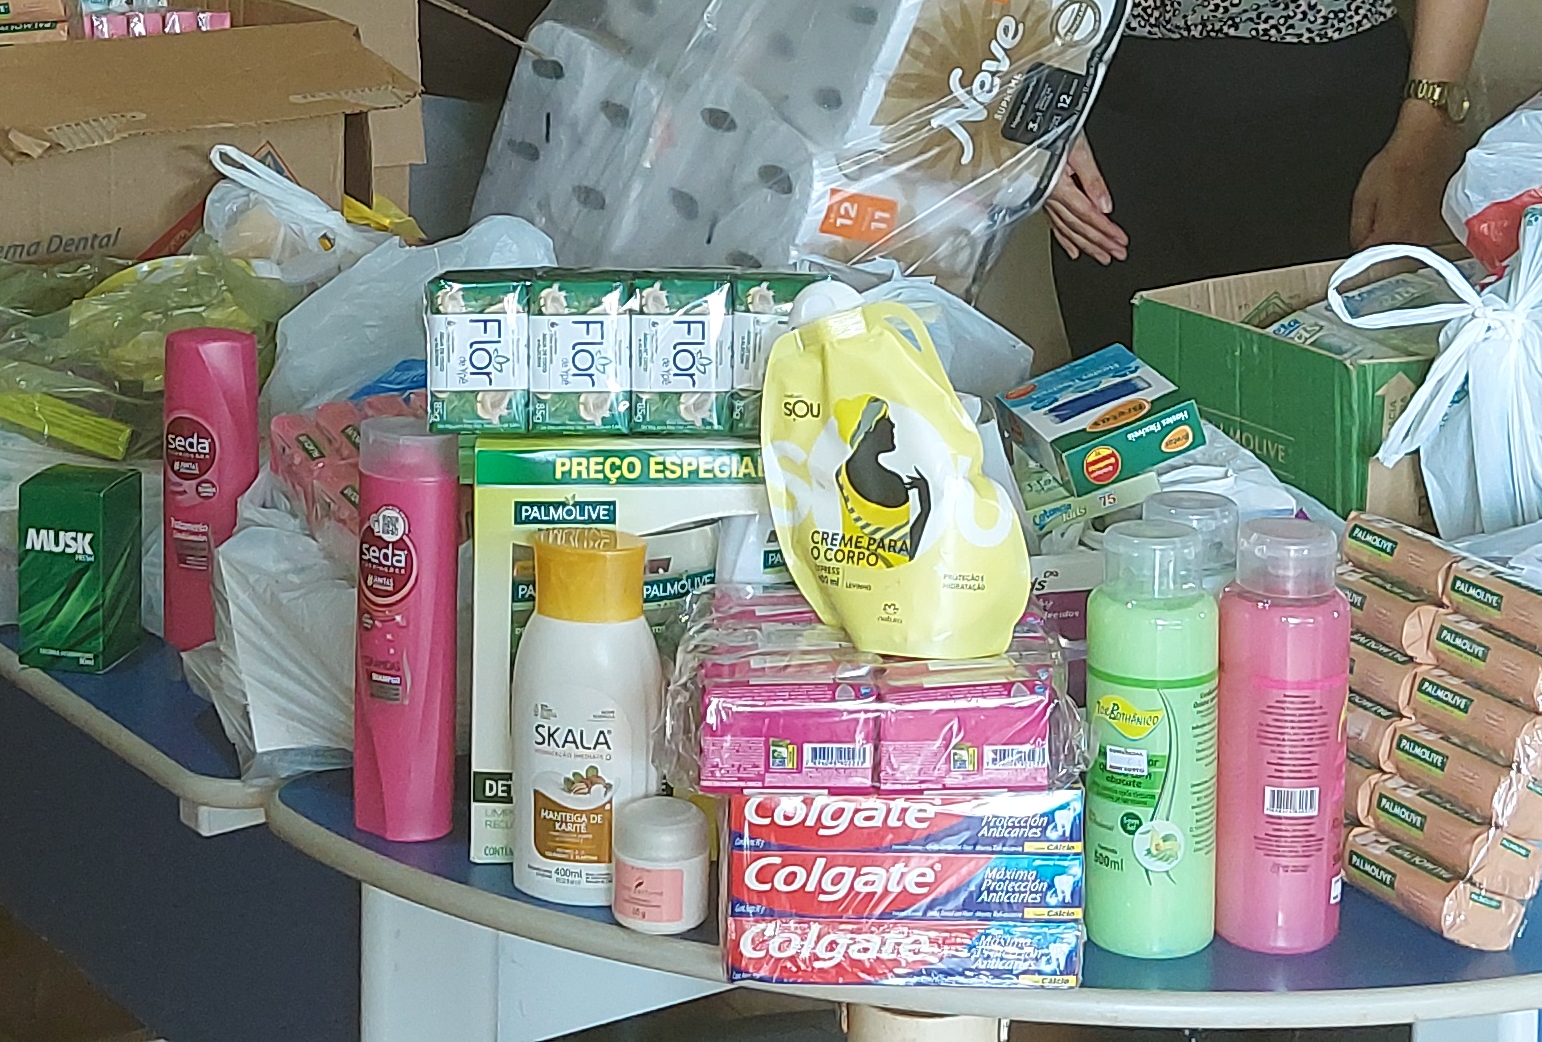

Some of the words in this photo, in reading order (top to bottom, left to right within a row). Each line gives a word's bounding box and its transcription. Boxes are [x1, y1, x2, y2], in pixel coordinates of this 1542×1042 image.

[930, 14, 1025, 166] Neve
[836, 201, 858, 228] 12
[870, 210, 891, 231] 11
[47, 226, 122, 258] Dental
[469, 318, 502, 387] Flor
[571, 320, 604, 388] Flor
[672, 320, 706, 389] Flor
[533, 402, 546, 423] 85g
[783, 398, 822, 420] SOU
[1161, 410, 1189, 428] Hastes
[168, 432, 210, 454] seda
[555, 456, 643, 485] PREÇO
[521, 504, 610, 521] PALMOLIVE
[1099, 493, 1117, 508] 75
[25, 527, 94, 555] MUSK
[811, 530, 864, 551] CREME
[865, 534, 910, 555] PARA
[1352, 525, 1396, 554] PALMOLIVE
[361, 543, 406, 567] seda
[811, 545, 820, 562] O
[823, 548, 880, 567] CORPO
[642, 575, 715, 598] PALMOLIVE
[1453, 577, 1499, 607] PALMOLIVE
[1440, 628, 1486, 658] PALMOLIVE
[1421, 679, 1468, 709] PALMOLIVE
[534, 723, 612, 751] SKALA
[1399, 738, 1446, 767] PALMOLIVE
[540, 808, 588, 824] MANTEIGA
[589, 814, 604, 824] DE
[744, 795, 936, 838] Colgate
[980, 814, 1048, 828] Protección
[1379, 797, 1423, 828] PALMOLIVE
[977, 825, 1042, 838] Anticaries
[553, 867, 583, 879] 400ml
[985, 864, 1037, 881] Máxima
[1093, 849, 1124, 872] 500ml
[1350, 854, 1394, 886] PALMOLIVE
[744, 856, 936, 903] Colgate
[980, 877, 1048, 892] Protección
[977, 890, 1042, 904] Anticaries
[739, 921, 932, 970] Colgate
